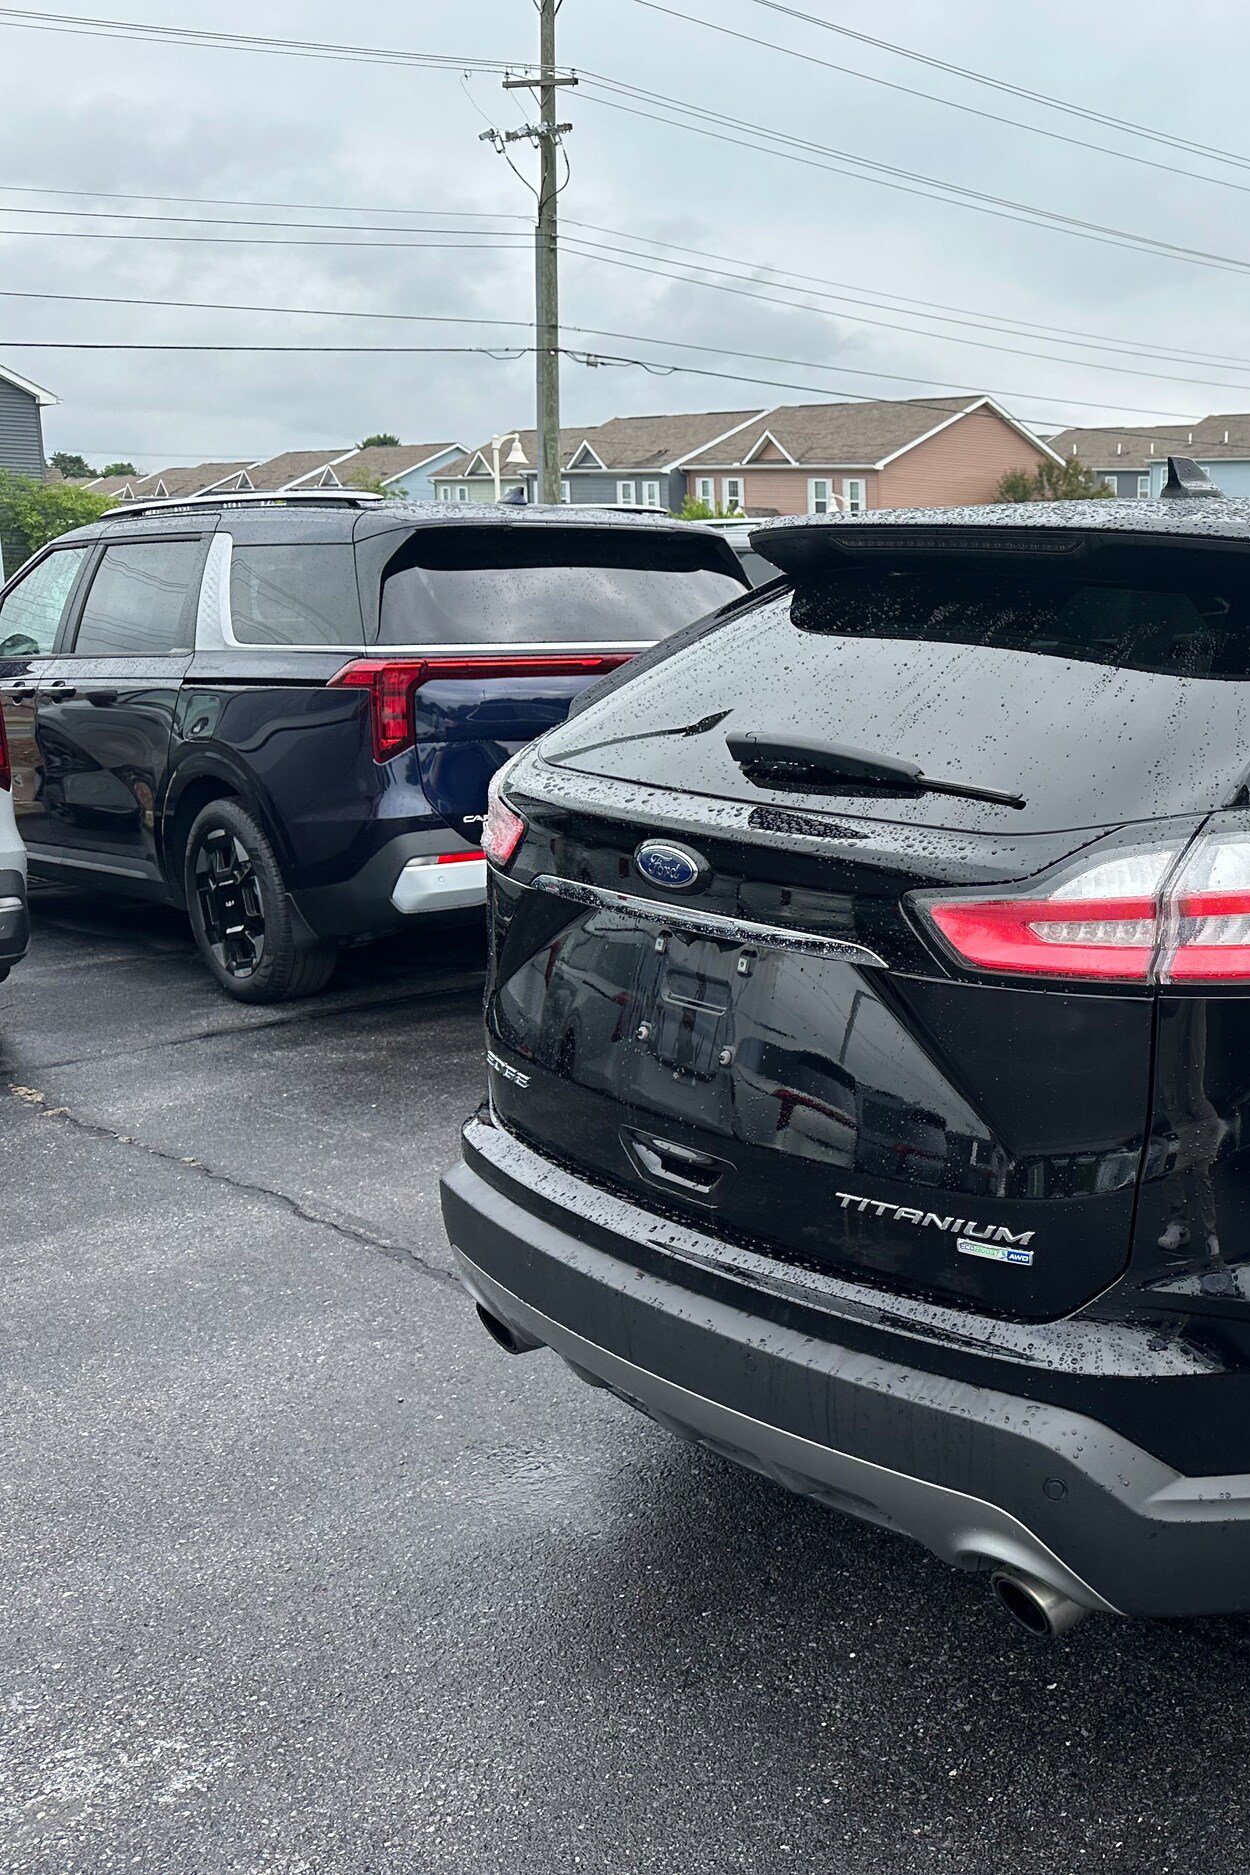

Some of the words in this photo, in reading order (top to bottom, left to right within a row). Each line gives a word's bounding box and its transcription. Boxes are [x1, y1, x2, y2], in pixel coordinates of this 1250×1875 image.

[648, 853, 681, 879] Ford
[835, 1191, 1036, 1246] TITANIUM
[1008, 1253, 1030, 1262] AWD
